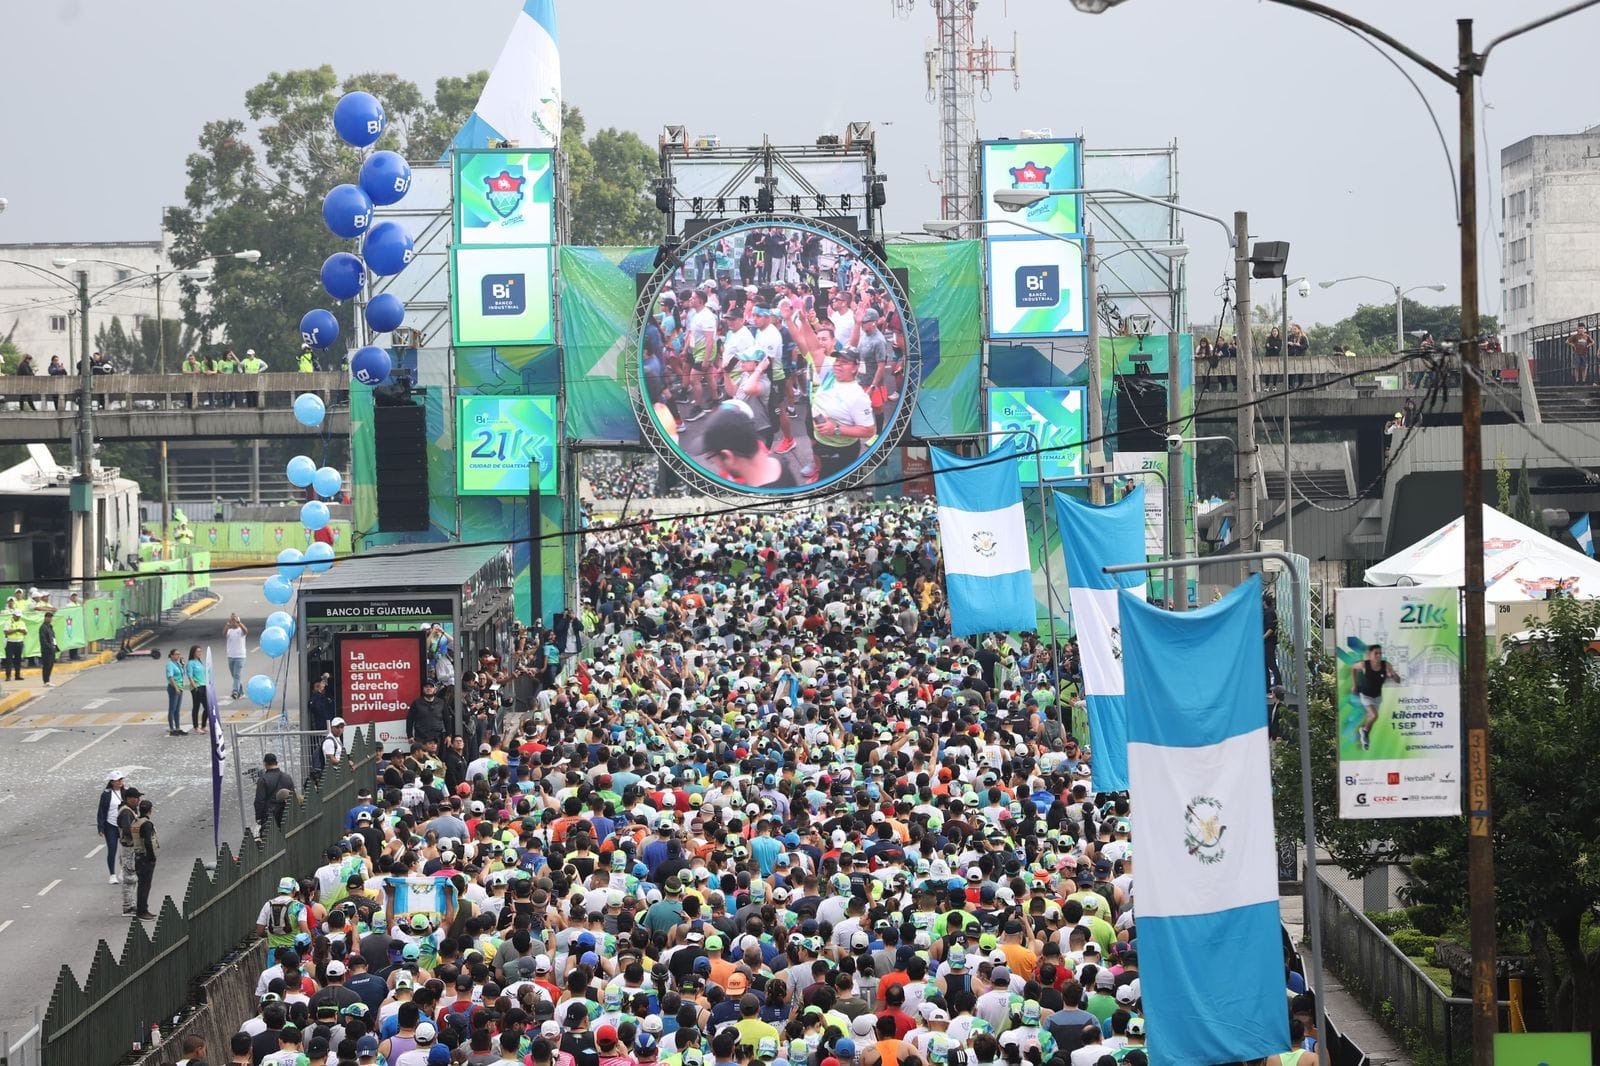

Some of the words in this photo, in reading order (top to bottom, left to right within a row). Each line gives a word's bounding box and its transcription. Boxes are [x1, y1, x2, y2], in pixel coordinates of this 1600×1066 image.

[367, 115, 383, 134] Bi
[394, 176, 411, 192] Bi
[354, 209, 371, 228] Bi
[1026, 272, 1047, 290] Bi
[492, 280, 514, 299] Bi
[302, 328, 319, 345] Bi
[326, 607, 360, 616] BANCO
[363, 607, 374, 615] DE
[377, 606, 432, 615] GUATEMALA
[1499, 605, 1510, 613] 250
[350, 651, 365, 660] La
[350, 660, 411, 670] educación
[350, 673, 364, 681] es
[367, 672, 381, 680] un
[351, 681, 399, 691] derecho
[369, 693, 384, 701] un
[351, 701, 411, 713] privilegio.
[1392, 722, 1396, 730] 1
[1398, 722, 1417, 730] SEP
[1356, 793, 1367, 804] G
